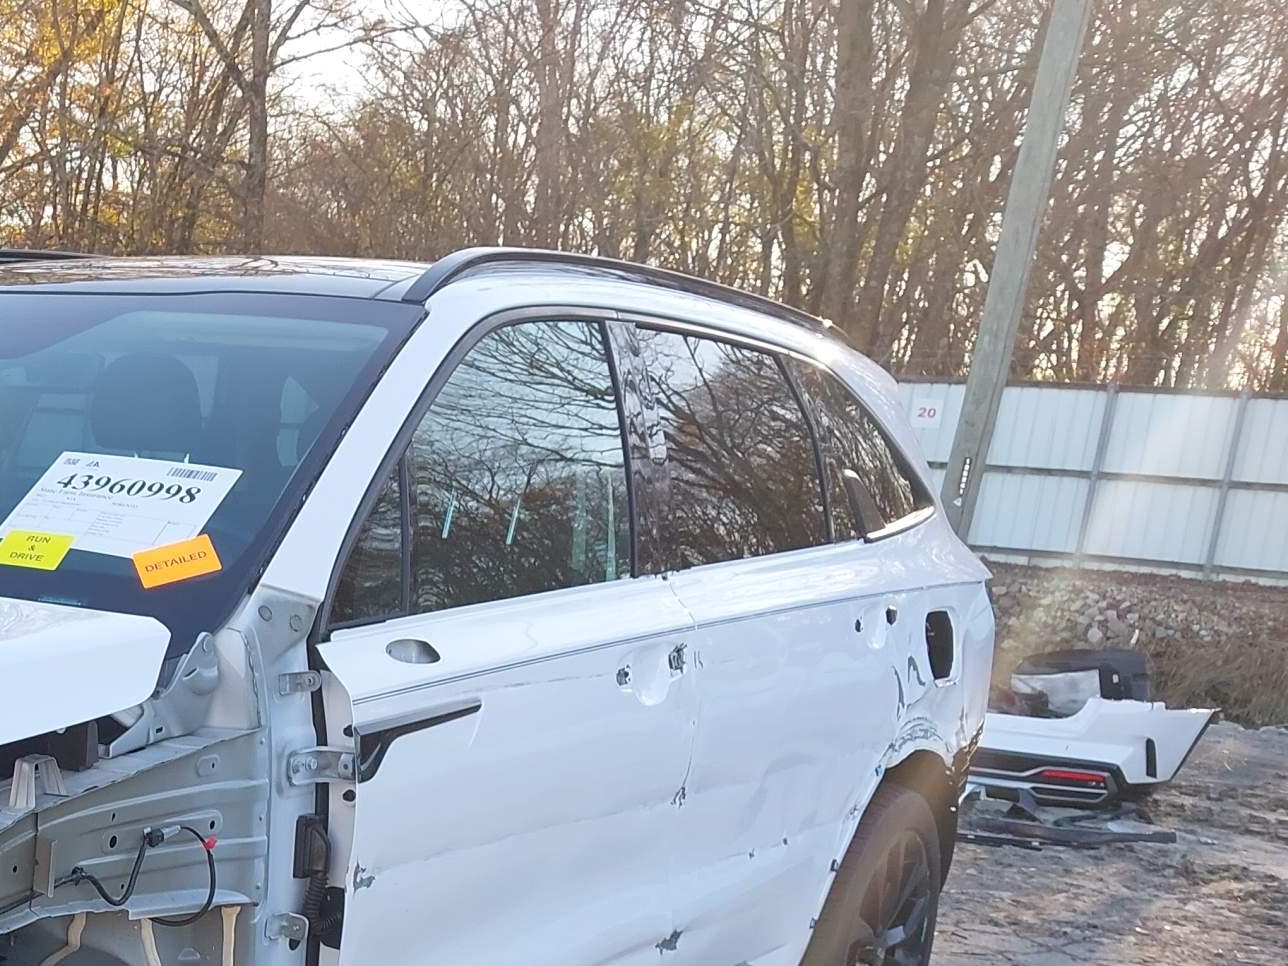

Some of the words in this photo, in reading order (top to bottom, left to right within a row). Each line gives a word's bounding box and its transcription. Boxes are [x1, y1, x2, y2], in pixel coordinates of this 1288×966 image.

[917, 407, 936, 419] 20
[58, 473, 202, 504] 43960998
[26, 535, 51, 544] RUN
[9, 551, 44, 562] DRIVE
[144, 551, 207, 573] DETAILED
